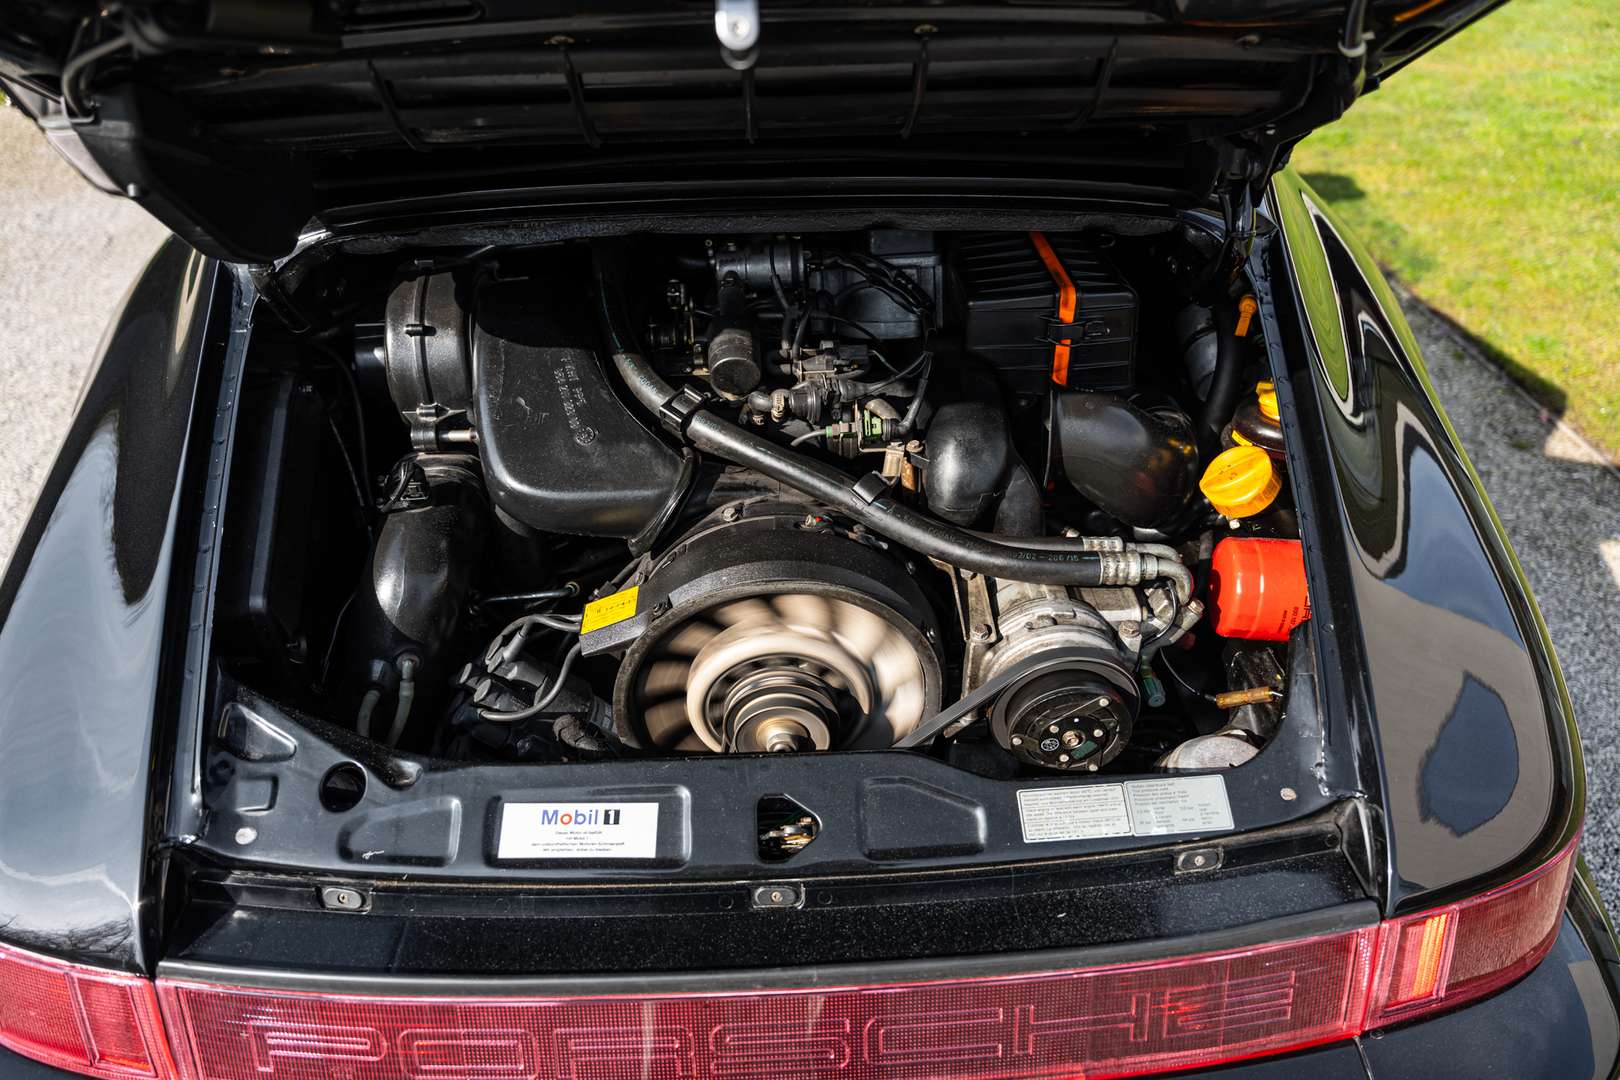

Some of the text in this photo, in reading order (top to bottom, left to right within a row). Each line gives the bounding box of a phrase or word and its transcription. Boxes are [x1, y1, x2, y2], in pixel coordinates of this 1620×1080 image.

[541, 809, 619, 825] Mobil 1
[249, 969, 1295, 1079] PORSCHE
